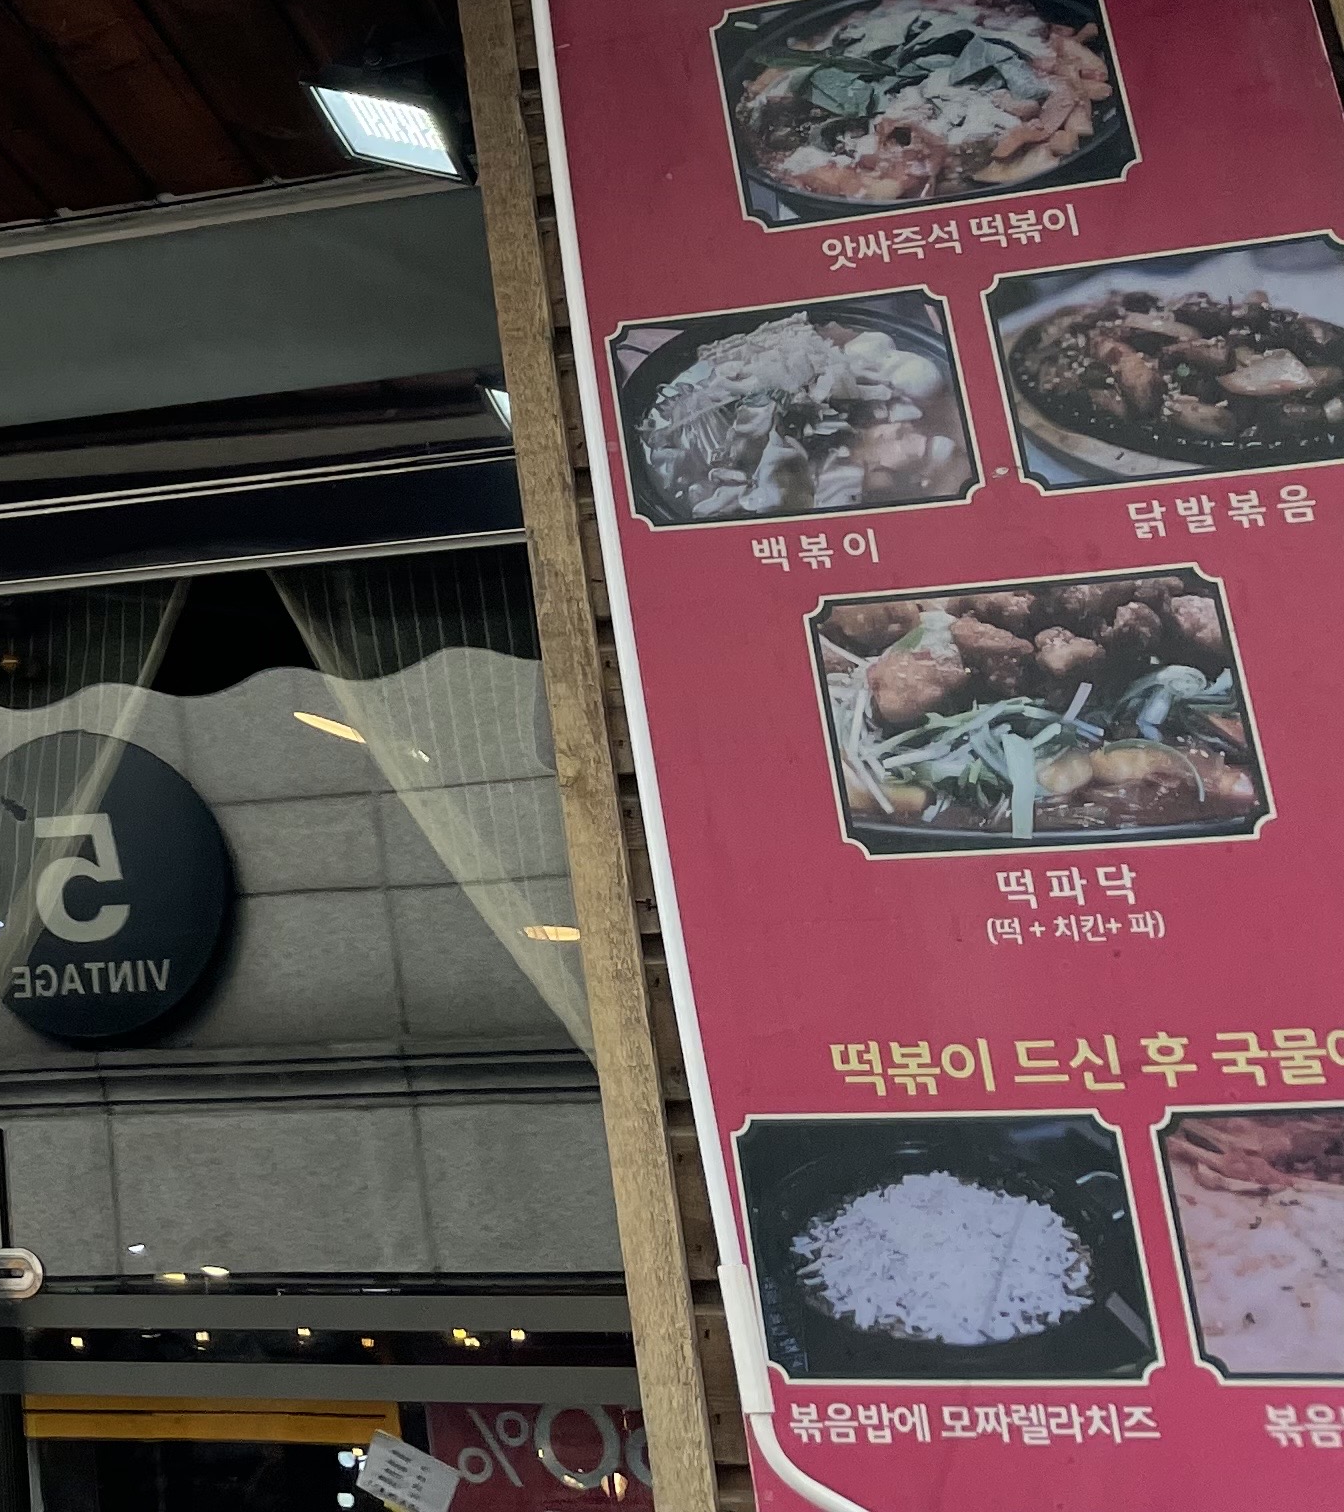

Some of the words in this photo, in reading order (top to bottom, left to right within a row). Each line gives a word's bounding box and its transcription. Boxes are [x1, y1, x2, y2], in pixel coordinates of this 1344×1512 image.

[821, 221, 964, 272] 앗싸즉석
[969, 203, 1081, 250] 떡볶이
[1127, 485, 1317, 540] 닭발볶음
[750, 528, 881, 573] 백볶이
[996, 864, 1137, 909] 떡파닥
[987, 917, 1023, 944] (떡
[1130, 910, 1166, 939] 파)
[829, 1038, 996, 1096] 떡볶이
[1014, 1034, 1127, 1091] 드신
[1140, 1031, 1198, 1088] 후
[790, 1402, 931, 1443] 볶음밥에
[941, 1403, 1162, 1446] 모짜렐라치즈
[1264, 1403, 1344, 1449] 볶음
